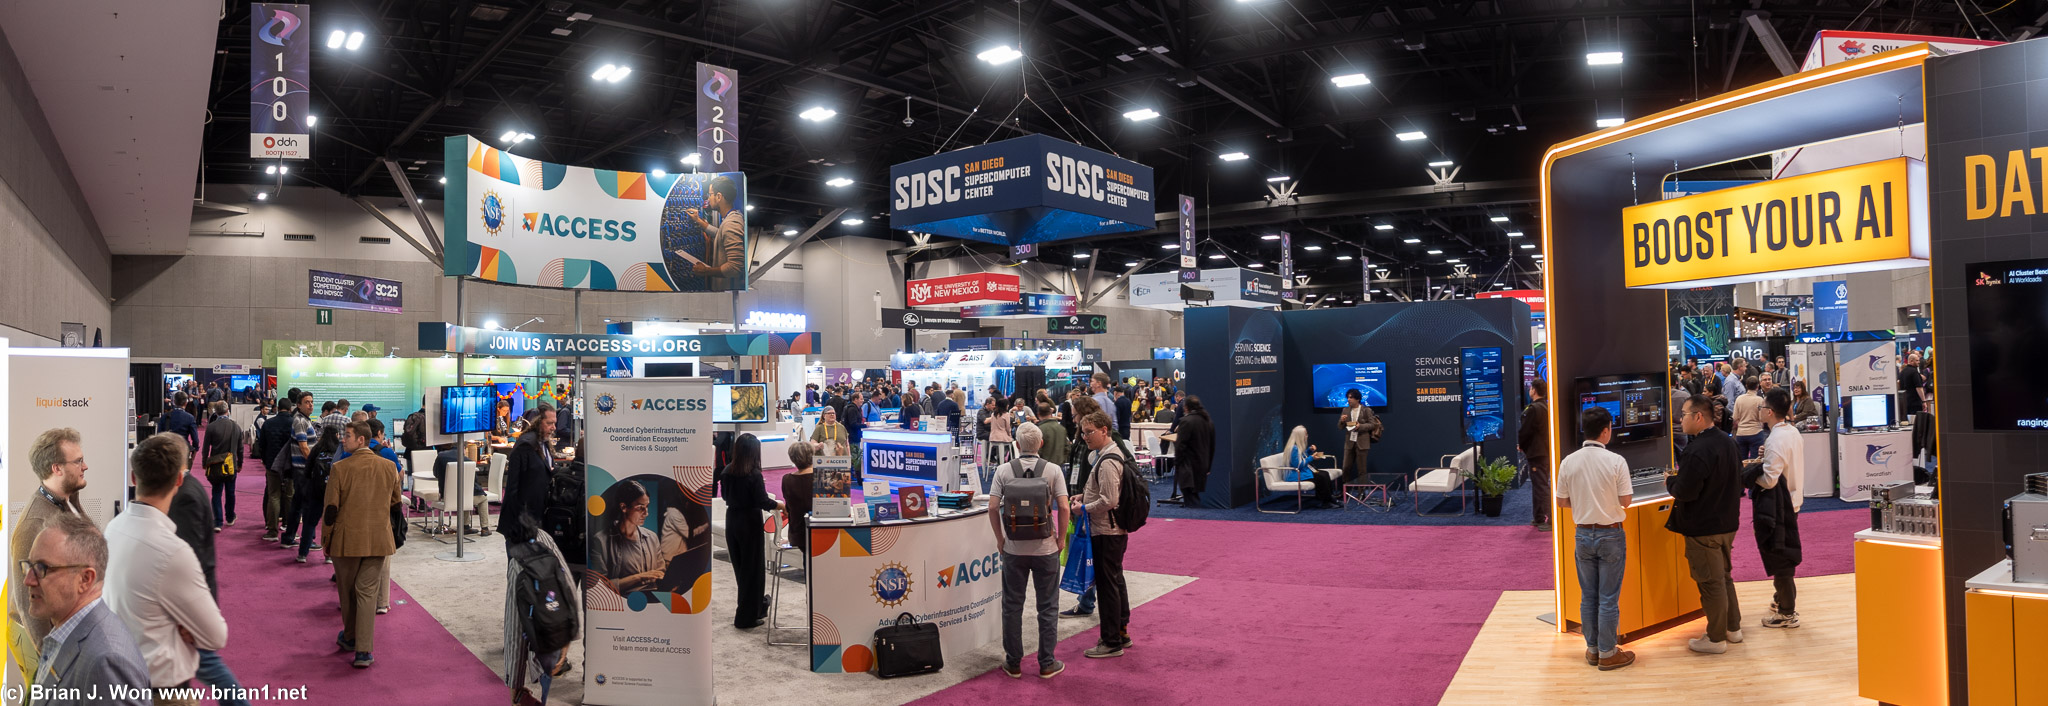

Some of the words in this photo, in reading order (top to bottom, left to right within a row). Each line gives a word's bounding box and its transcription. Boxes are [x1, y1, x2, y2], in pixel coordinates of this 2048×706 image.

[272, 52, 287, 122] 100
[712, 106, 724, 165] 200
[277, 137, 297, 147] ddn
[964, 162, 980, 174] SAN
[981, 157, 1005, 172] DIEGO
[964, 165, 1031, 187] SUPERCOMPUTER
[1046, 152, 1105, 202] SDSC
[1106, 169, 1118, 180] SAN
[1118, 171, 1134, 186] DIEGO
[895, 166, 961, 211] SDSC
[964, 185, 994, 200] CENTER
[1106, 181, 1150, 202] SUPERCOMPUTER
[1107, 196, 1128, 208] CENTER
[484, 205, 502, 221] NSF
[538, 213, 637, 242] ACCESS
[1633, 207, 1733, 268] BOOST
[1741, 190, 1844, 254] YOUR
[1854, 181, 1894, 241] AI
[1015, 244, 1031, 255] 300
[313, 275, 334, 284] STUDENT
[335, 278, 355, 286] CLUSTER
[1182, 271, 1196, 280] 400
[313, 282, 343, 291] COMPETITION
[944, 281, 971, 289] UNIVERSITY
[1985, 279, 2001, 287] hynix
[375, 284, 398, 298] SC25
[934, 289, 951, 298] NEW
[952, 286, 980, 296] MEXICO
[489, 335, 518, 350] JOIN
[521, 336, 541, 351] US
[544, 338, 564, 352] AT
[565, 339, 701, 352] ACCESS-CI.ORG
[1235, 343, 1254, 352] SERVING
[1254, 343, 1271, 352] SCIENCE
[1235, 355, 1253, 365] SERVING
[1260, 355, 1277, 364] NATION
[1415, 357, 1452, 366] SERVING
[609, 369, 632, 377] JONHON
[1415, 368, 1452, 376] SERVING
[36, 397, 89, 408] liquidstack
[643, 399, 707, 411] ACCESS
[635, 427, 696, 435] Cyberinfrastructure
[654, 445, 678, 453] Support
[870, 449, 904, 470] SDSC
[905, 458, 937, 466] SUPERCOMPUTER
[1857, 484, 1875, 492] SNI
[876, 577, 907, 592] NSF
[915, 605, 970, 623] Cyberinfrastructure
[970, 595, 995, 610] Coordination
[939, 616, 963, 628] Services
[968, 608, 986, 621] Support
[626, 636, 671, 645] ACCESS-CI.org
